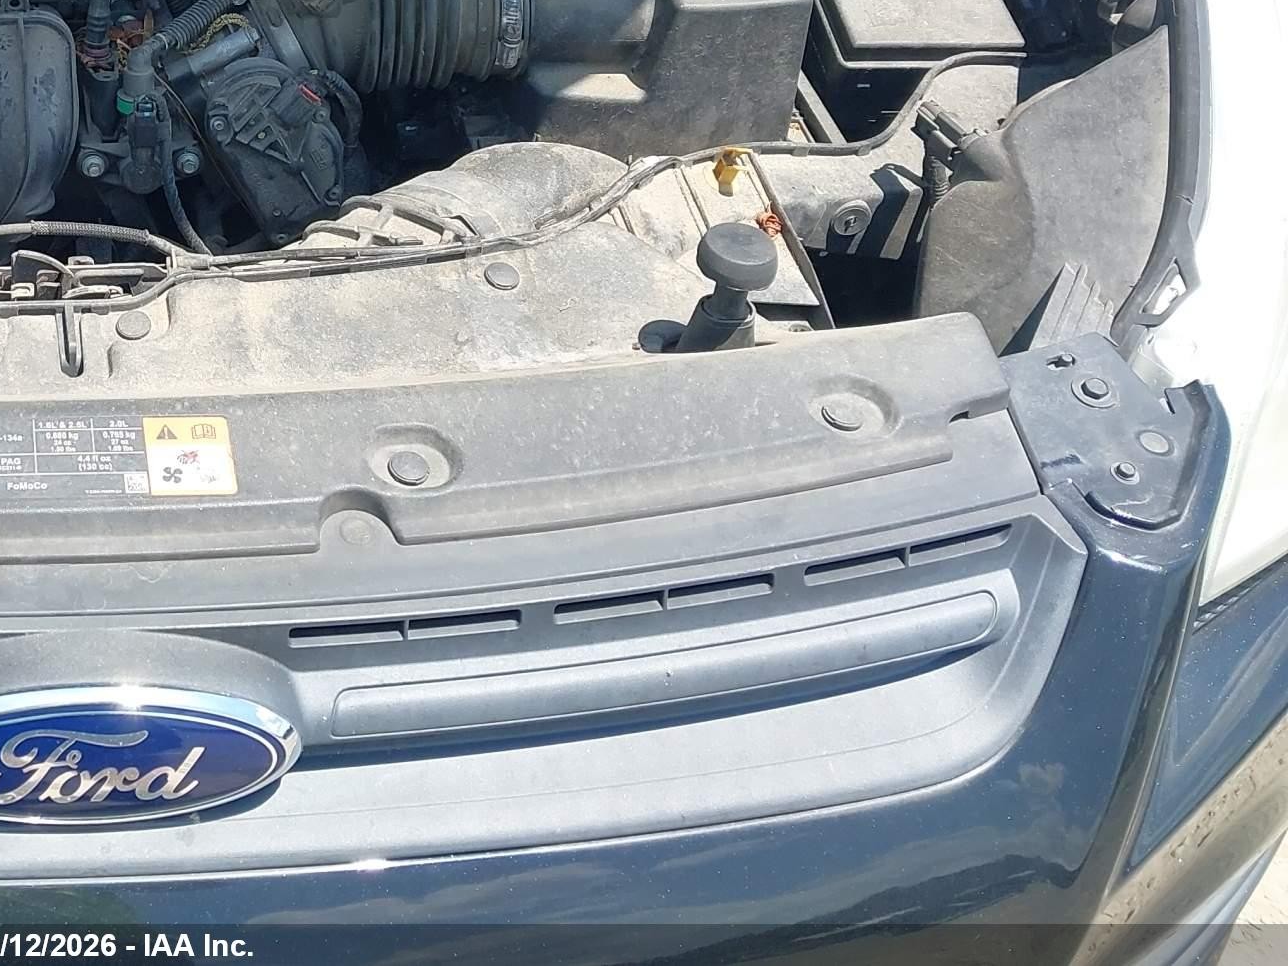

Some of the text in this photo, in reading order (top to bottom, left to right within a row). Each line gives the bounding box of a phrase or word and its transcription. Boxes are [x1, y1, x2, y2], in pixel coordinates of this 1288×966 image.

[68, 431, 79, 441] kg
[125, 430, 136, 440] kg
[0, 457, 22, 466] PAG
[77, 454, 91, 462] 4.4
[78, 462, 97, 472] (130
[6, 481, 48, 491] FoMoCo
